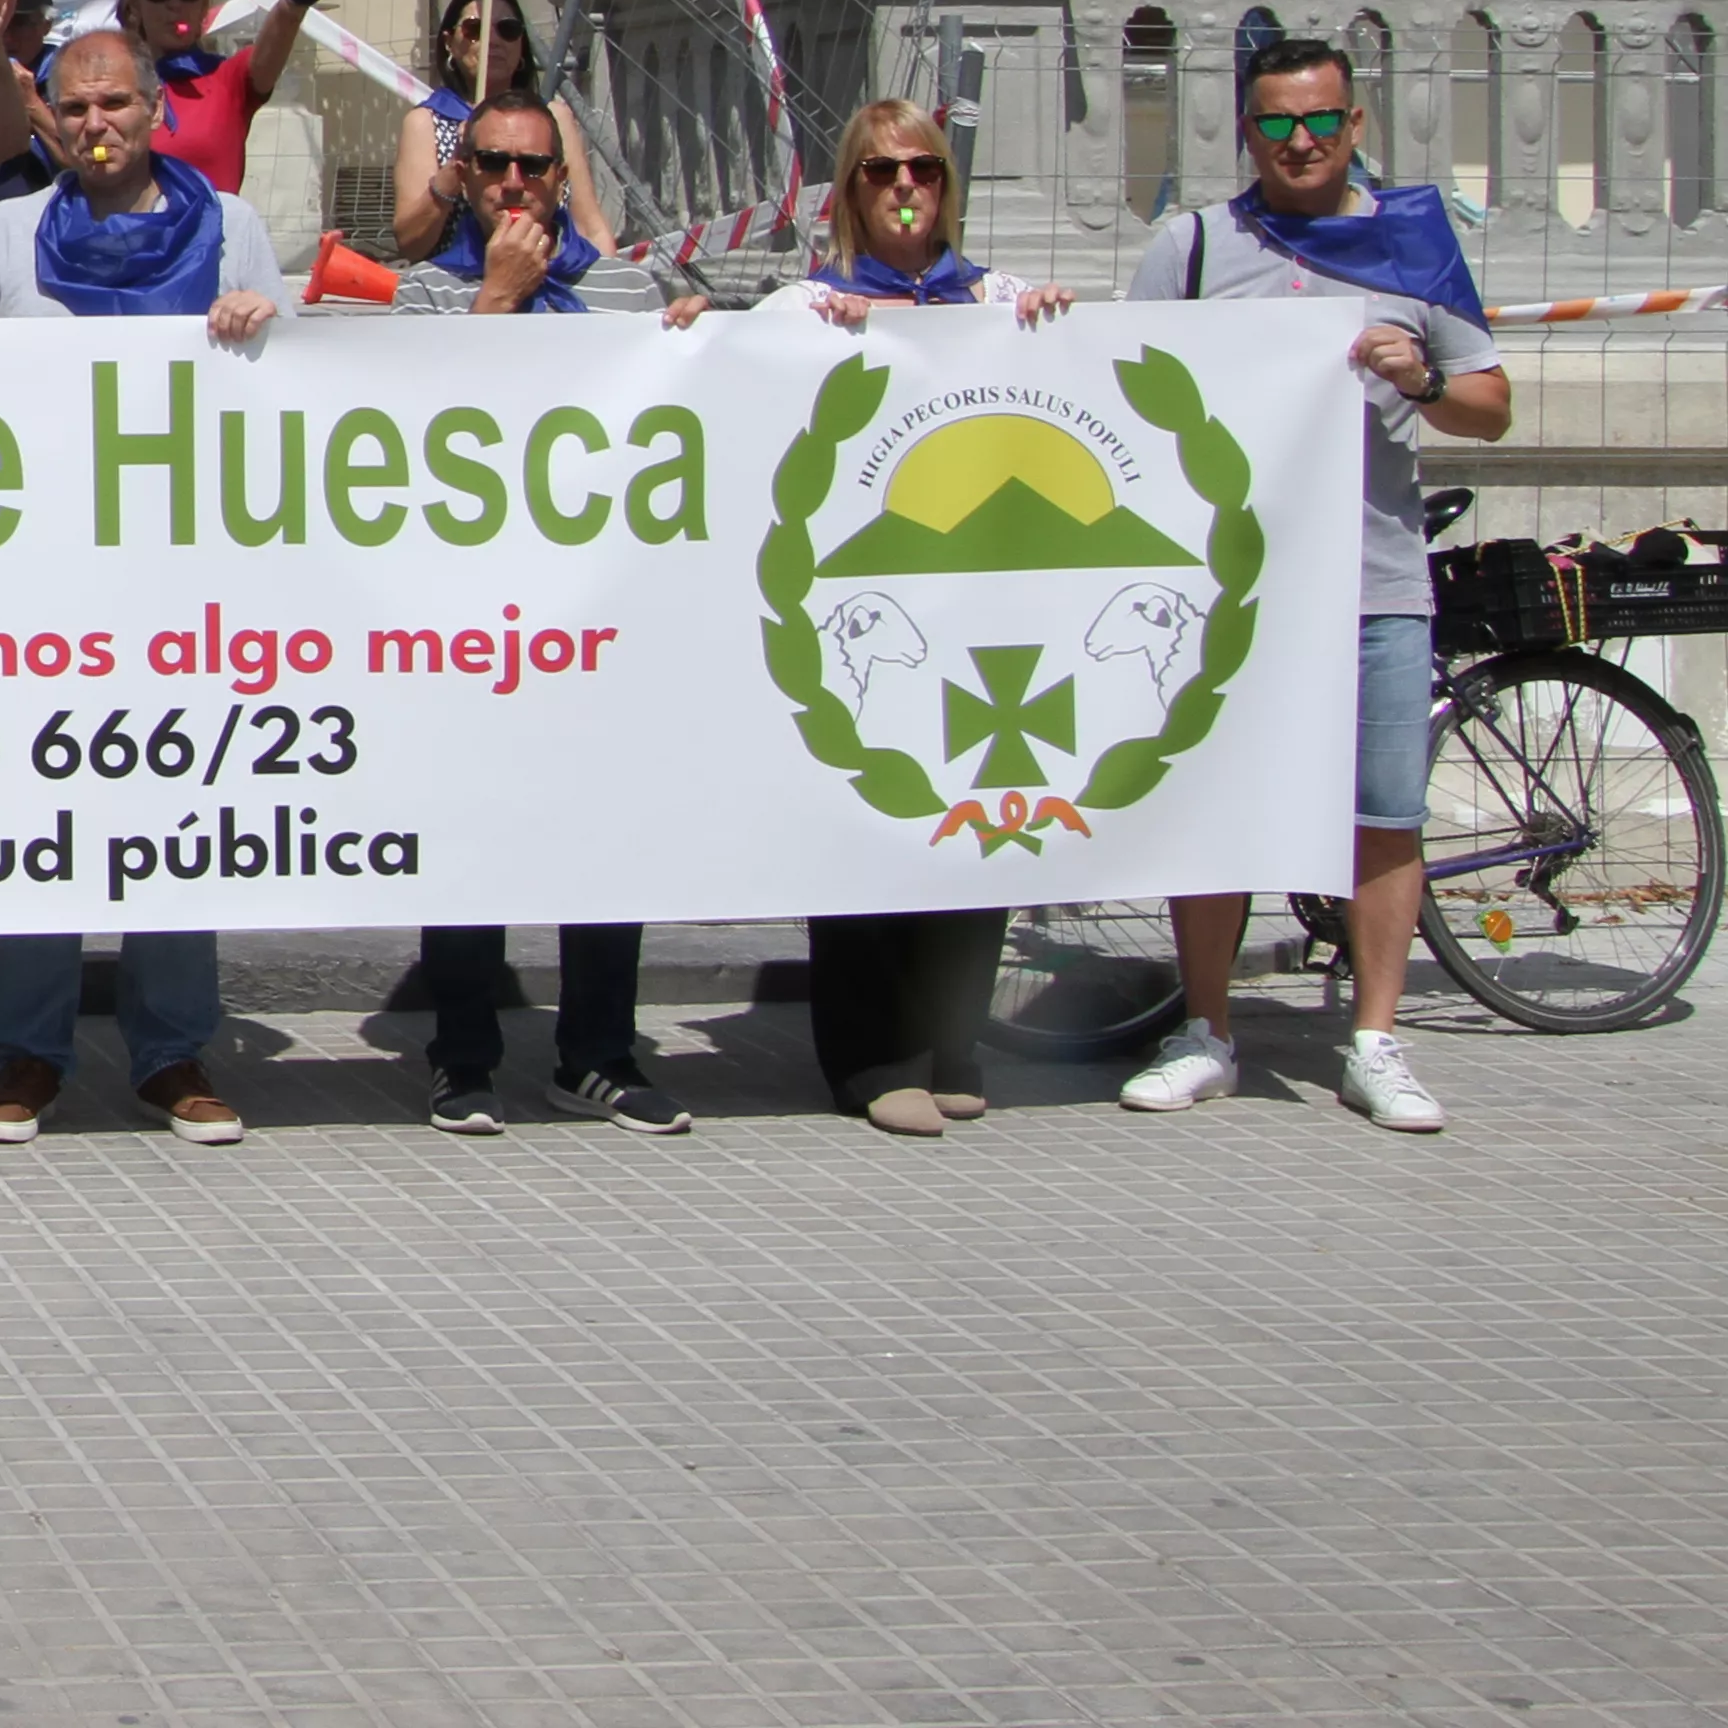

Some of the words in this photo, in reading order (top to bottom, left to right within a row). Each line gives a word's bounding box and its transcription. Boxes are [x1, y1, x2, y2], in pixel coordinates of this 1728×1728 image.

[91, 360, 710, 548] Huesca
[857, 427, 904, 489] HIGIA
[902, 385, 1000, 431] PECORIS
[1005, 385, 1074, 418] SALUS
[1074, 409, 1142, 484] POPULI
[147, 602, 334, 696] algo
[367, 603, 619, 695] mejor
[31, 704, 358, 786] 666/23
[108, 804, 420, 902] pública
